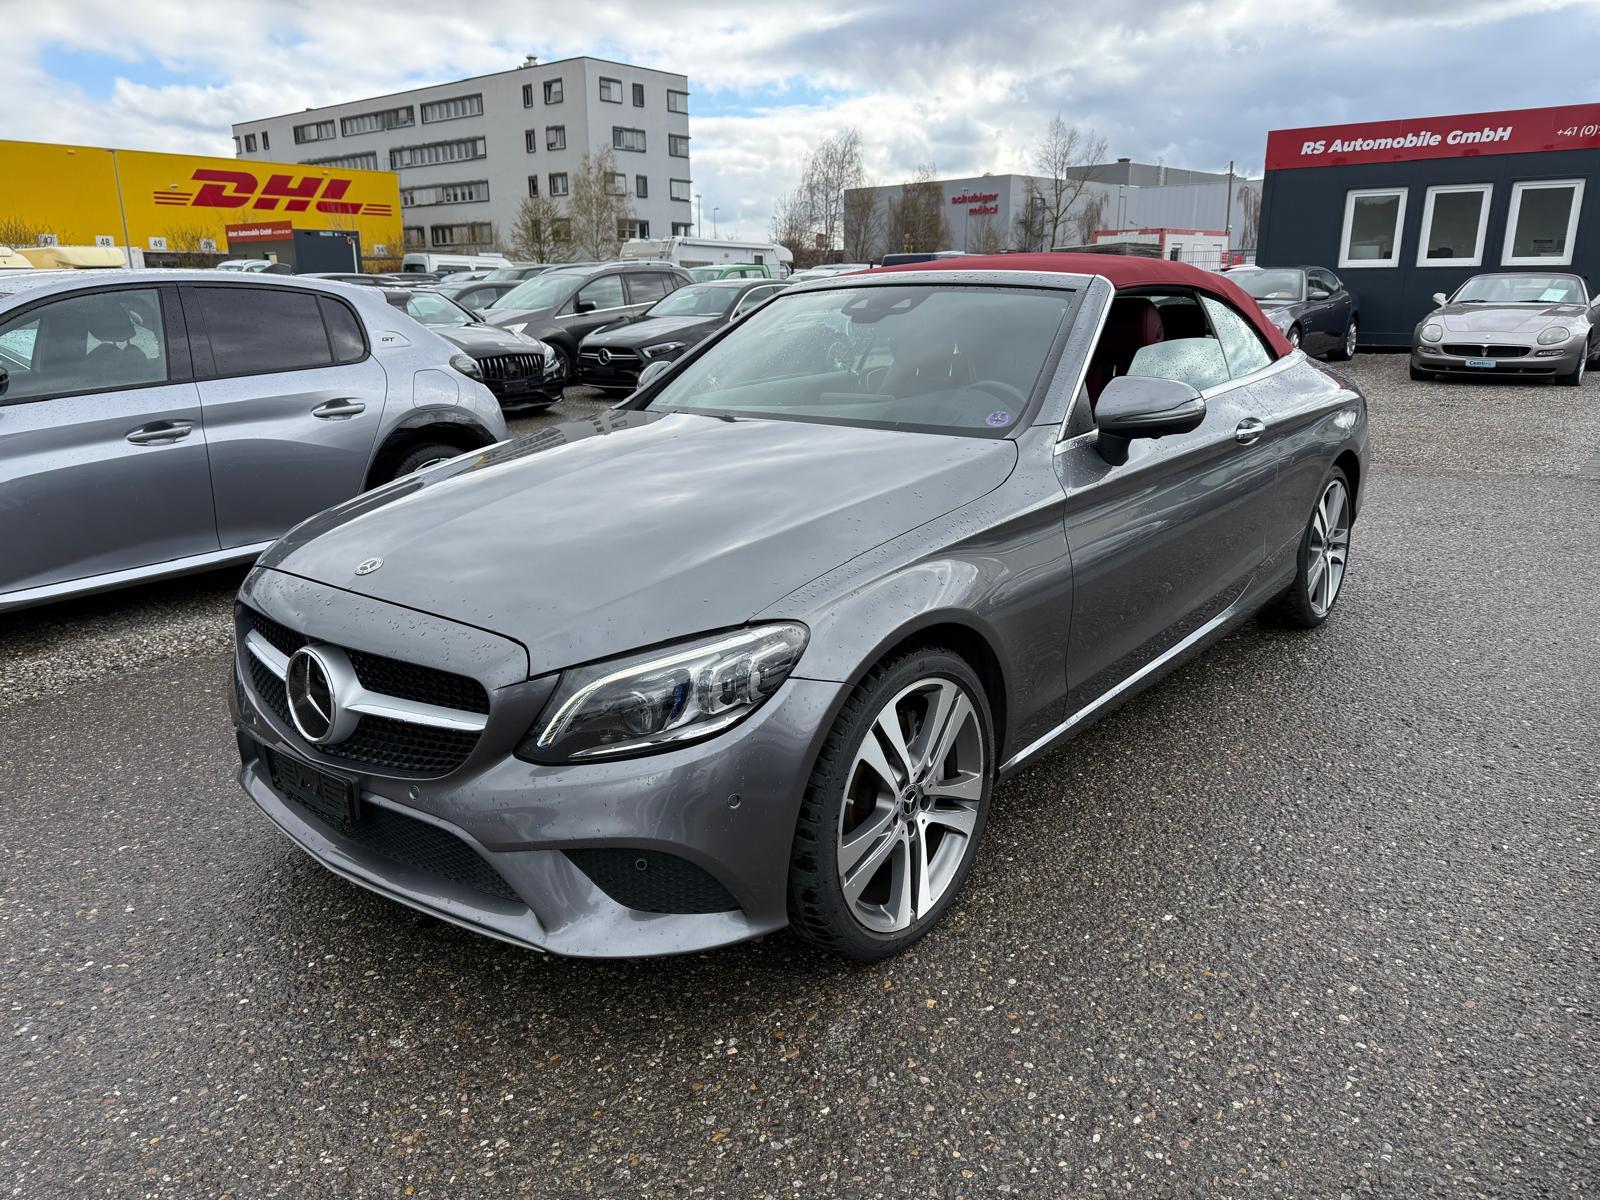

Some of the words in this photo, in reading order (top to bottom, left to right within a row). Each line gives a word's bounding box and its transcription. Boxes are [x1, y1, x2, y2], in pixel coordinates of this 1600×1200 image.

[1556, 126, 1578, 137] +41
[1580, 124, 1600, 138] (0)
[1300, 140, 1325, 156] RS
[1328, 130, 1442, 153] Automobile
[1446, 126, 1513, 145] GmbH
[190, 168, 363, 215] DHL
[951, 193, 999, 205] schubiger
[100, 238, 111, 247] 48
[152, 239, 163, 248] 49
